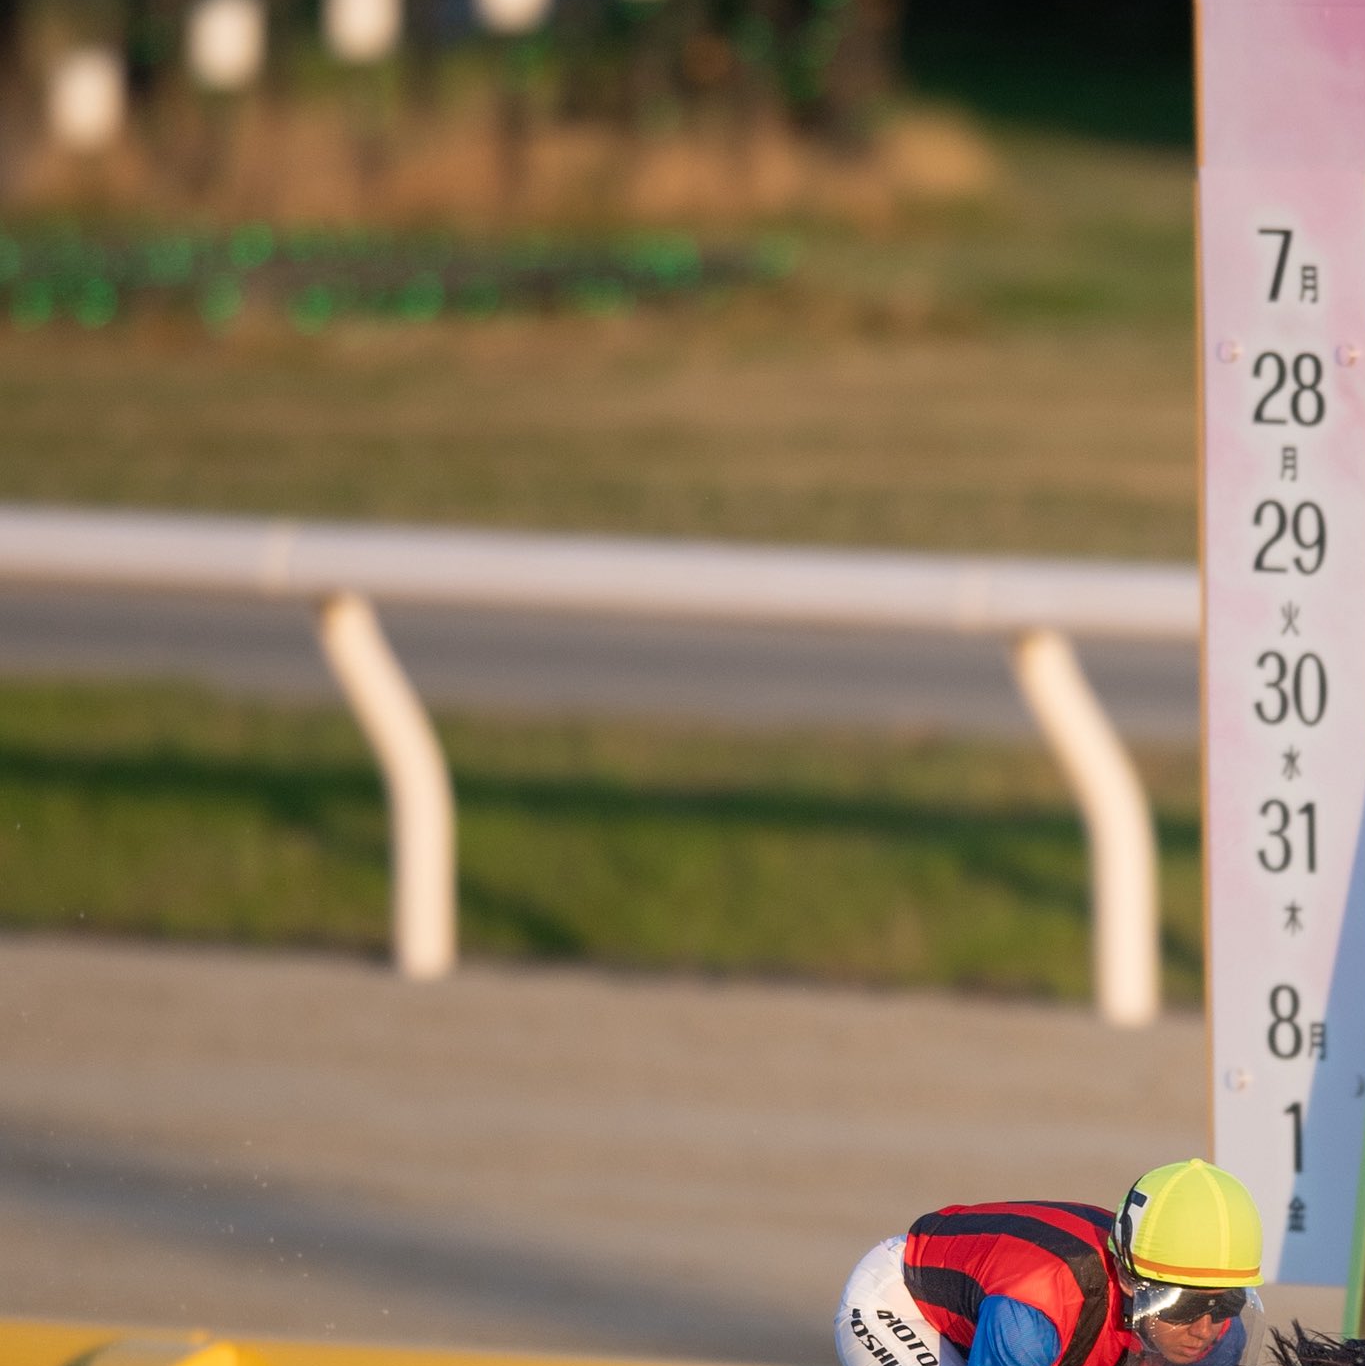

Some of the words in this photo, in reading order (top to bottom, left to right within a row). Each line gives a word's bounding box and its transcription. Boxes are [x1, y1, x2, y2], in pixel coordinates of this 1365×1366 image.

[1252, 350, 1326, 428] 28
[1252, 498, 1328, 576] 29
[1253, 650, 1329, 727] 30
[1257, 798, 1317, 874] 31
[1283, 1101, 1304, 1175] 1
